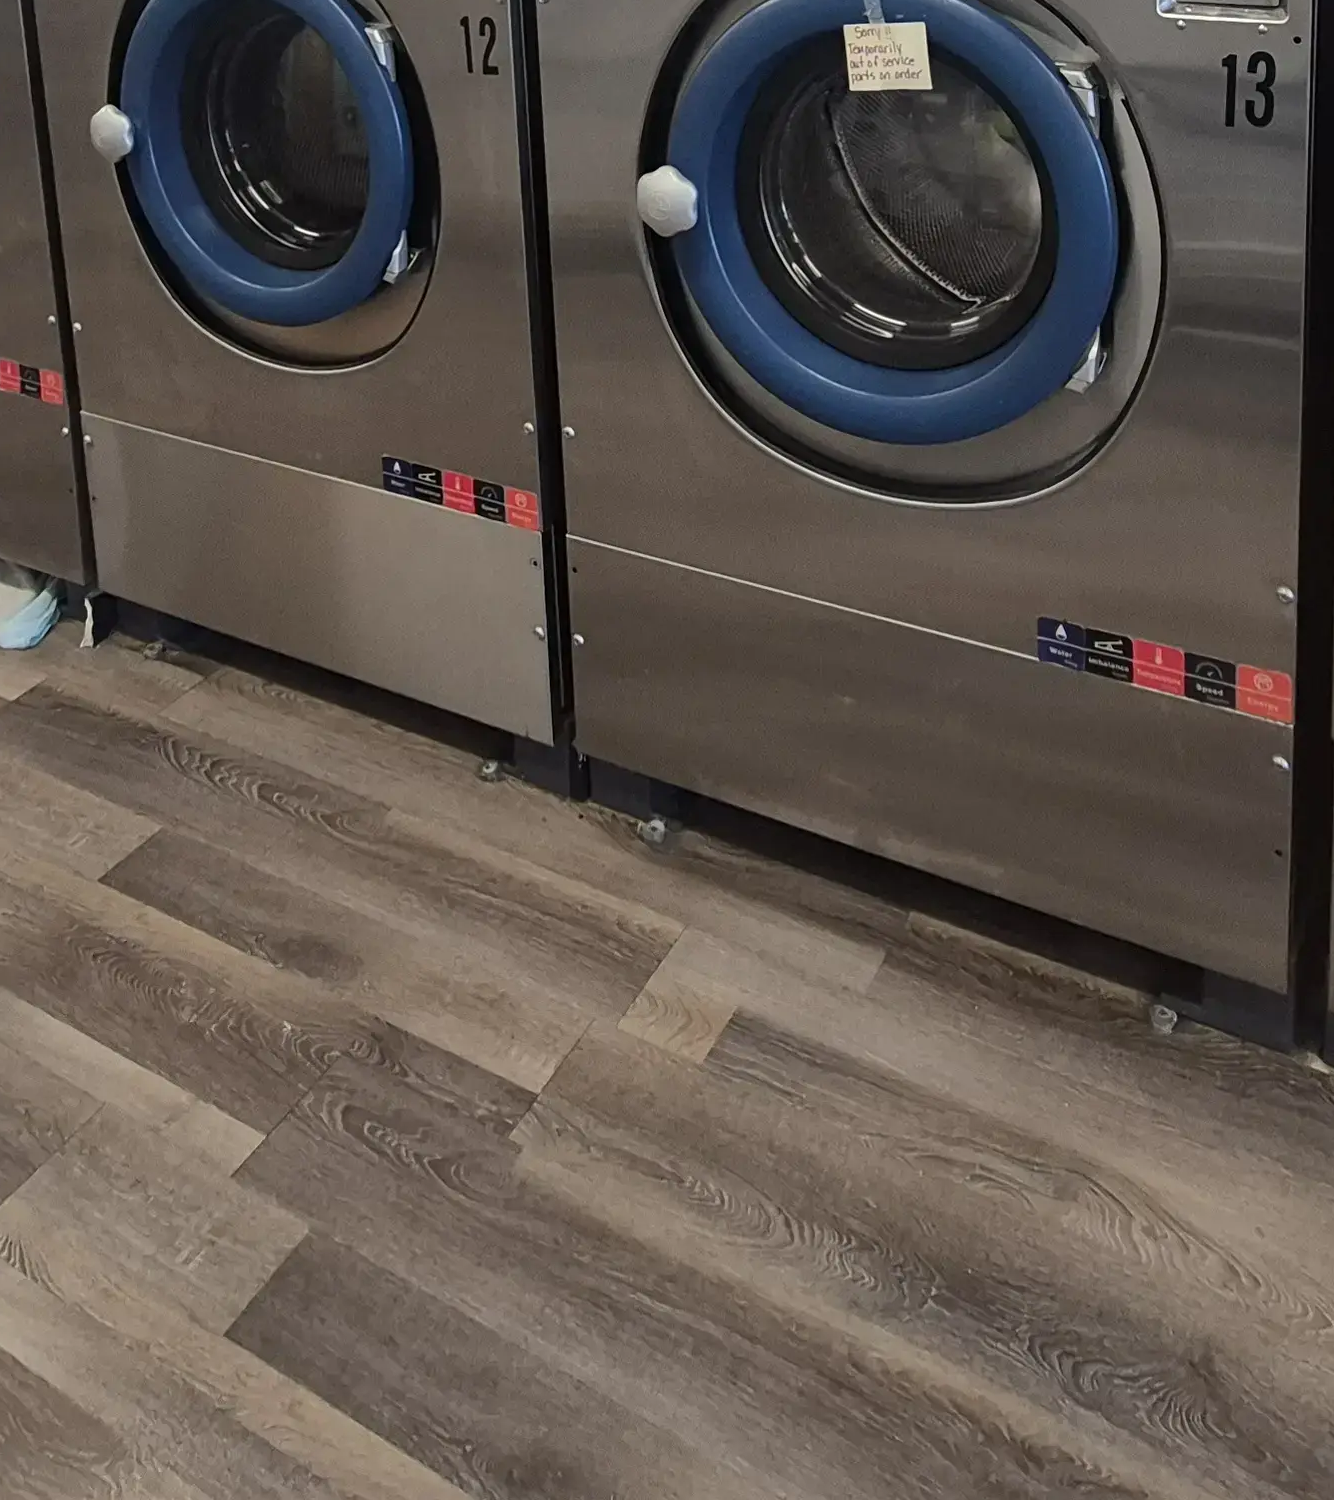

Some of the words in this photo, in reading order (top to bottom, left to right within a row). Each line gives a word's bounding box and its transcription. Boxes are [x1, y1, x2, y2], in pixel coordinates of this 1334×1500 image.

[458, 15, 500, 76] 12
[849, 56, 865, 69] out
[866, 55, 879, 68] of
[881, 56, 916, 68] service
[851, 70, 876, 85] parts
[879, 71, 891, 81] on
[894, 68, 923, 80] order
[1219, 50, 1277, 130] 13
[1048, 645, 1074, 659] Water
[1194, 683, 1224, 698] Speed
